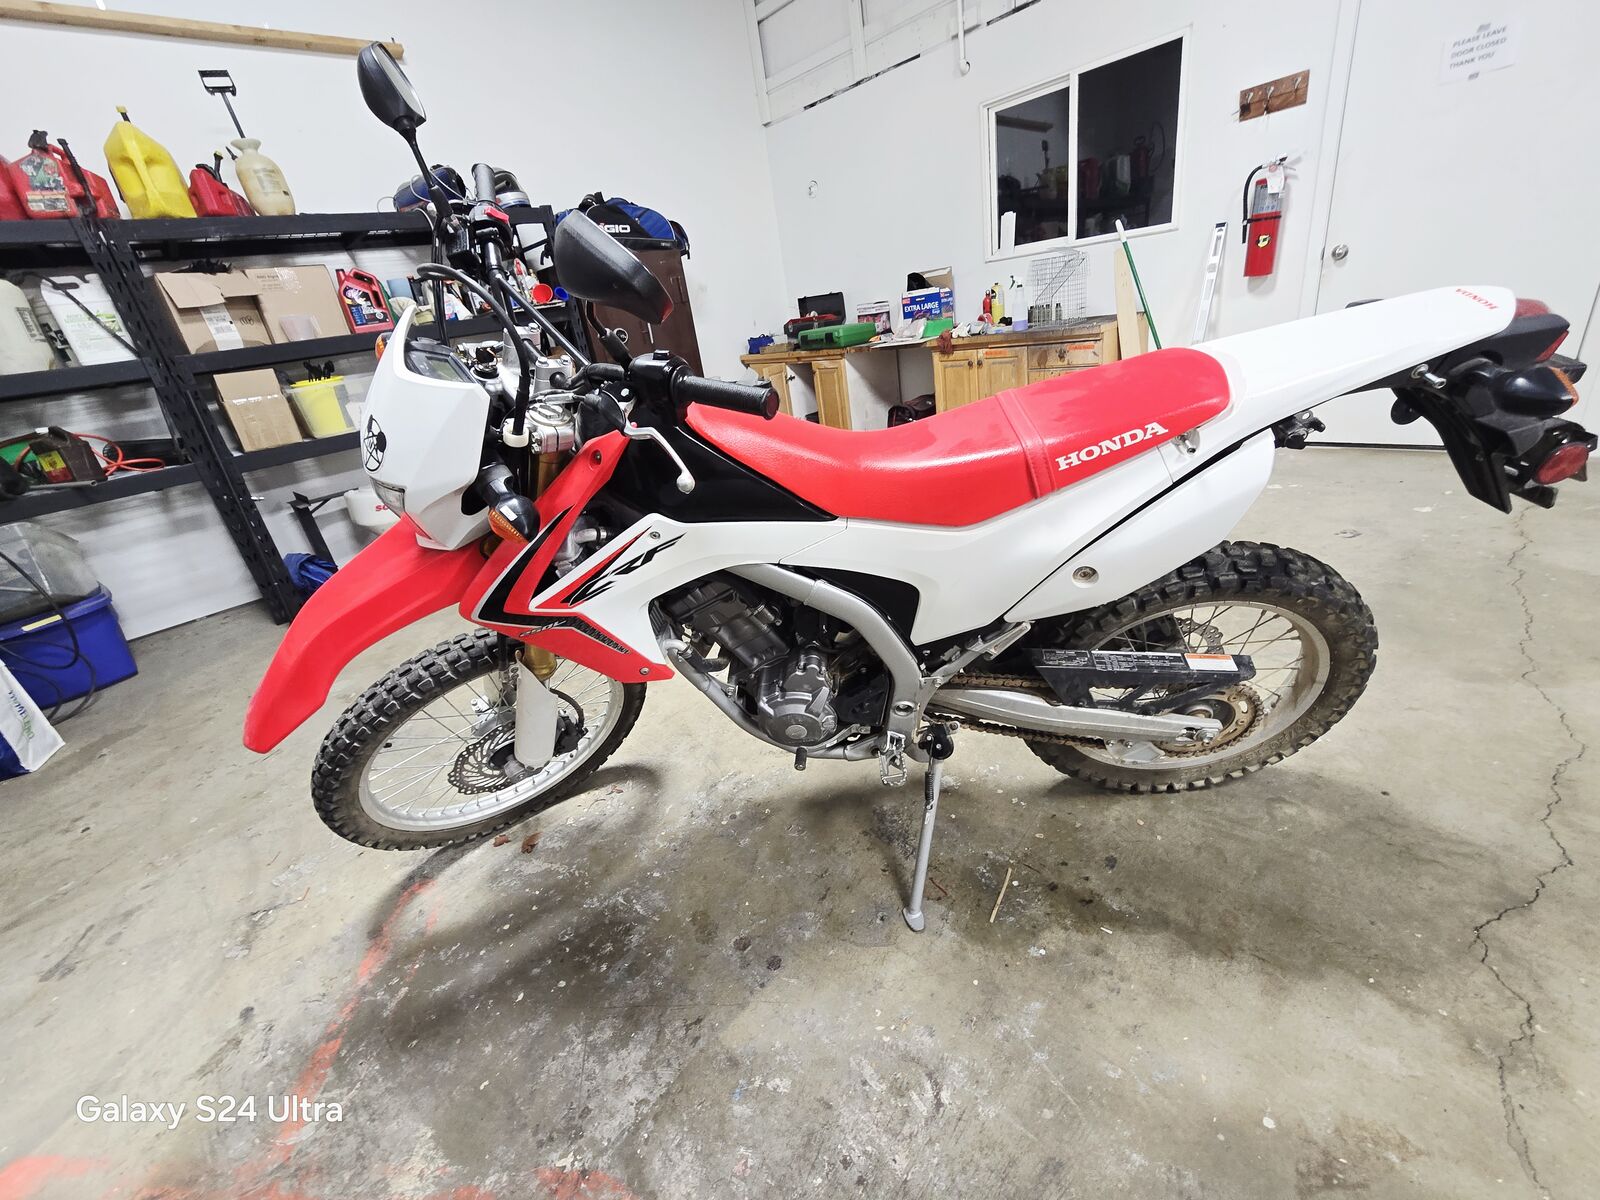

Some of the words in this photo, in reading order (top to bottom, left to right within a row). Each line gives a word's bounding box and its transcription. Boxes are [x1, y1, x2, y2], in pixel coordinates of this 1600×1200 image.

[1449, 57, 1476, 70] THANK
[904, 303, 921, 313] EXTRA
[921, 301, 939, 311] LARGE
[1055, 421, 1169, 471] HONDA
[568, 531, 688, 606] CRF
